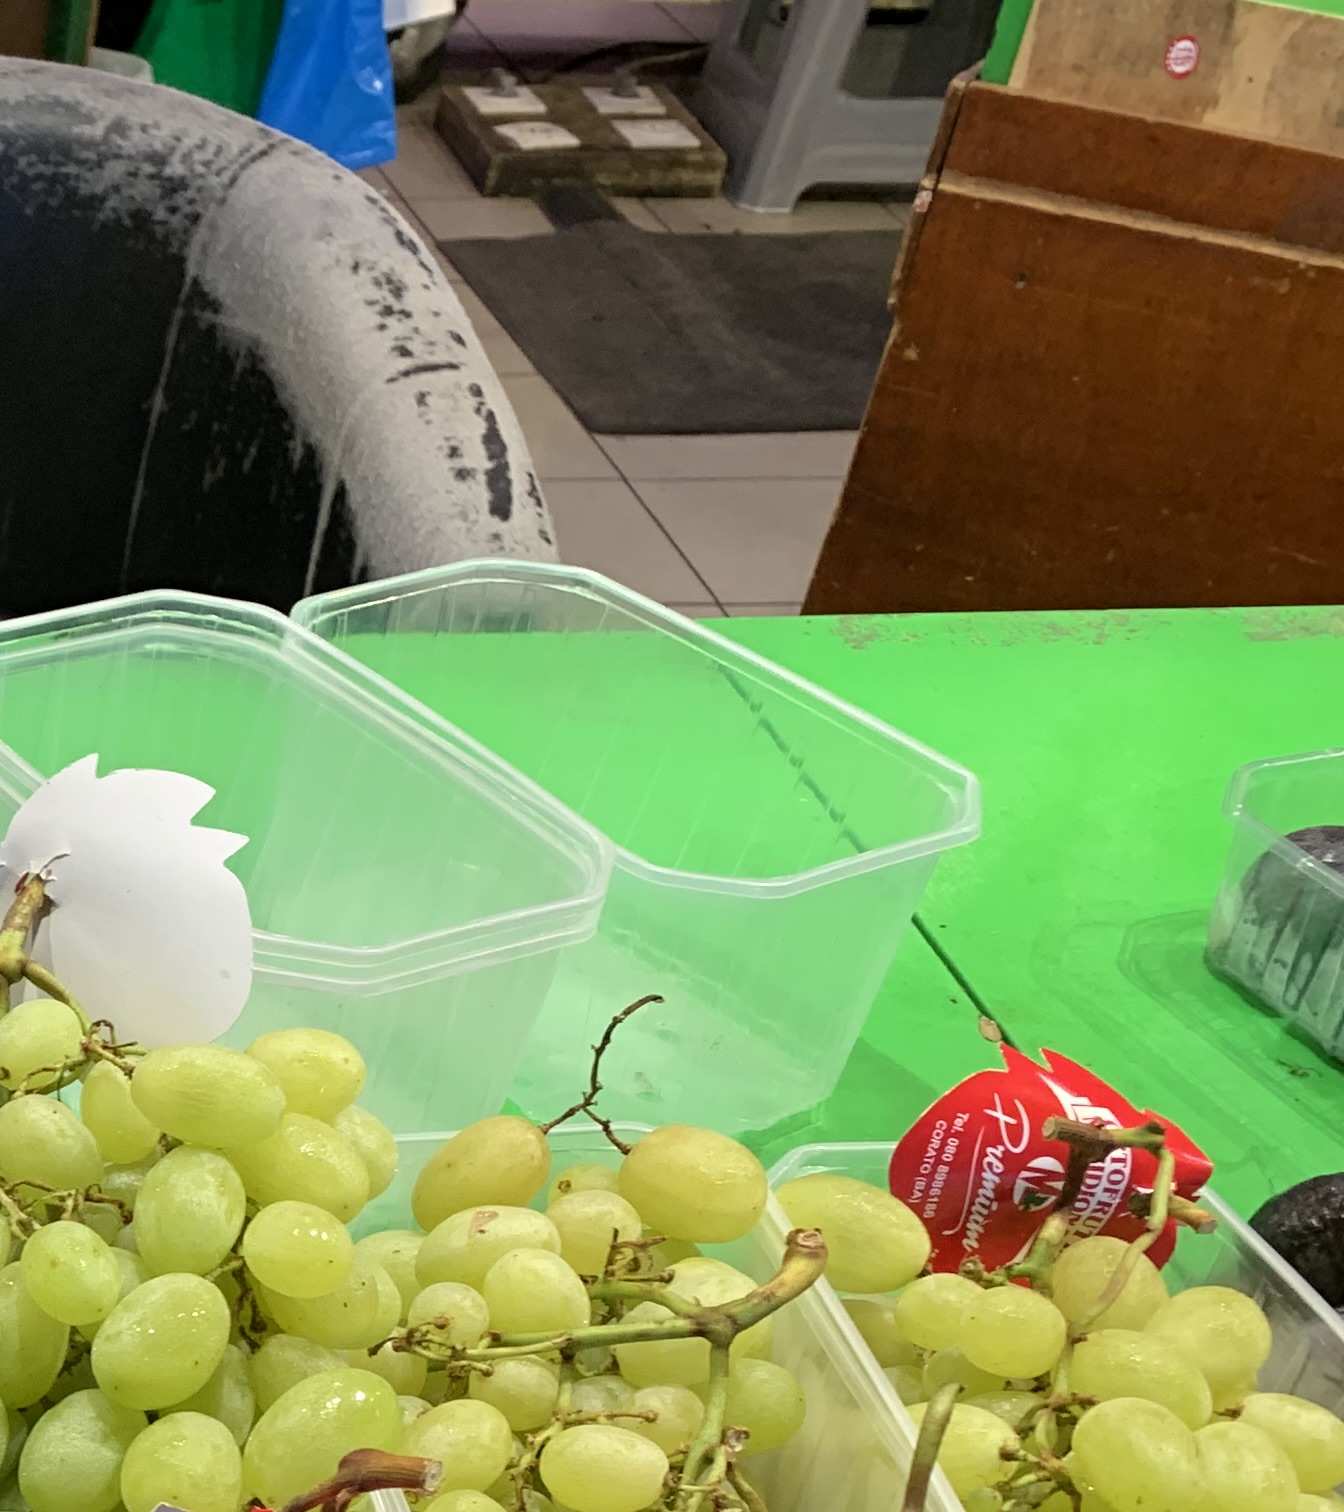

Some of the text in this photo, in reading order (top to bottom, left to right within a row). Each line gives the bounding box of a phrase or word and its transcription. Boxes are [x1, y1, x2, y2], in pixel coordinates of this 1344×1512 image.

[941, 1137, 960, 1162] 080
[950, 1112, 970, 1133] Tel.
[908, 1119, 948, 1204] CORATO (BA)
[962, 1092, 1031, 1252] Premium
